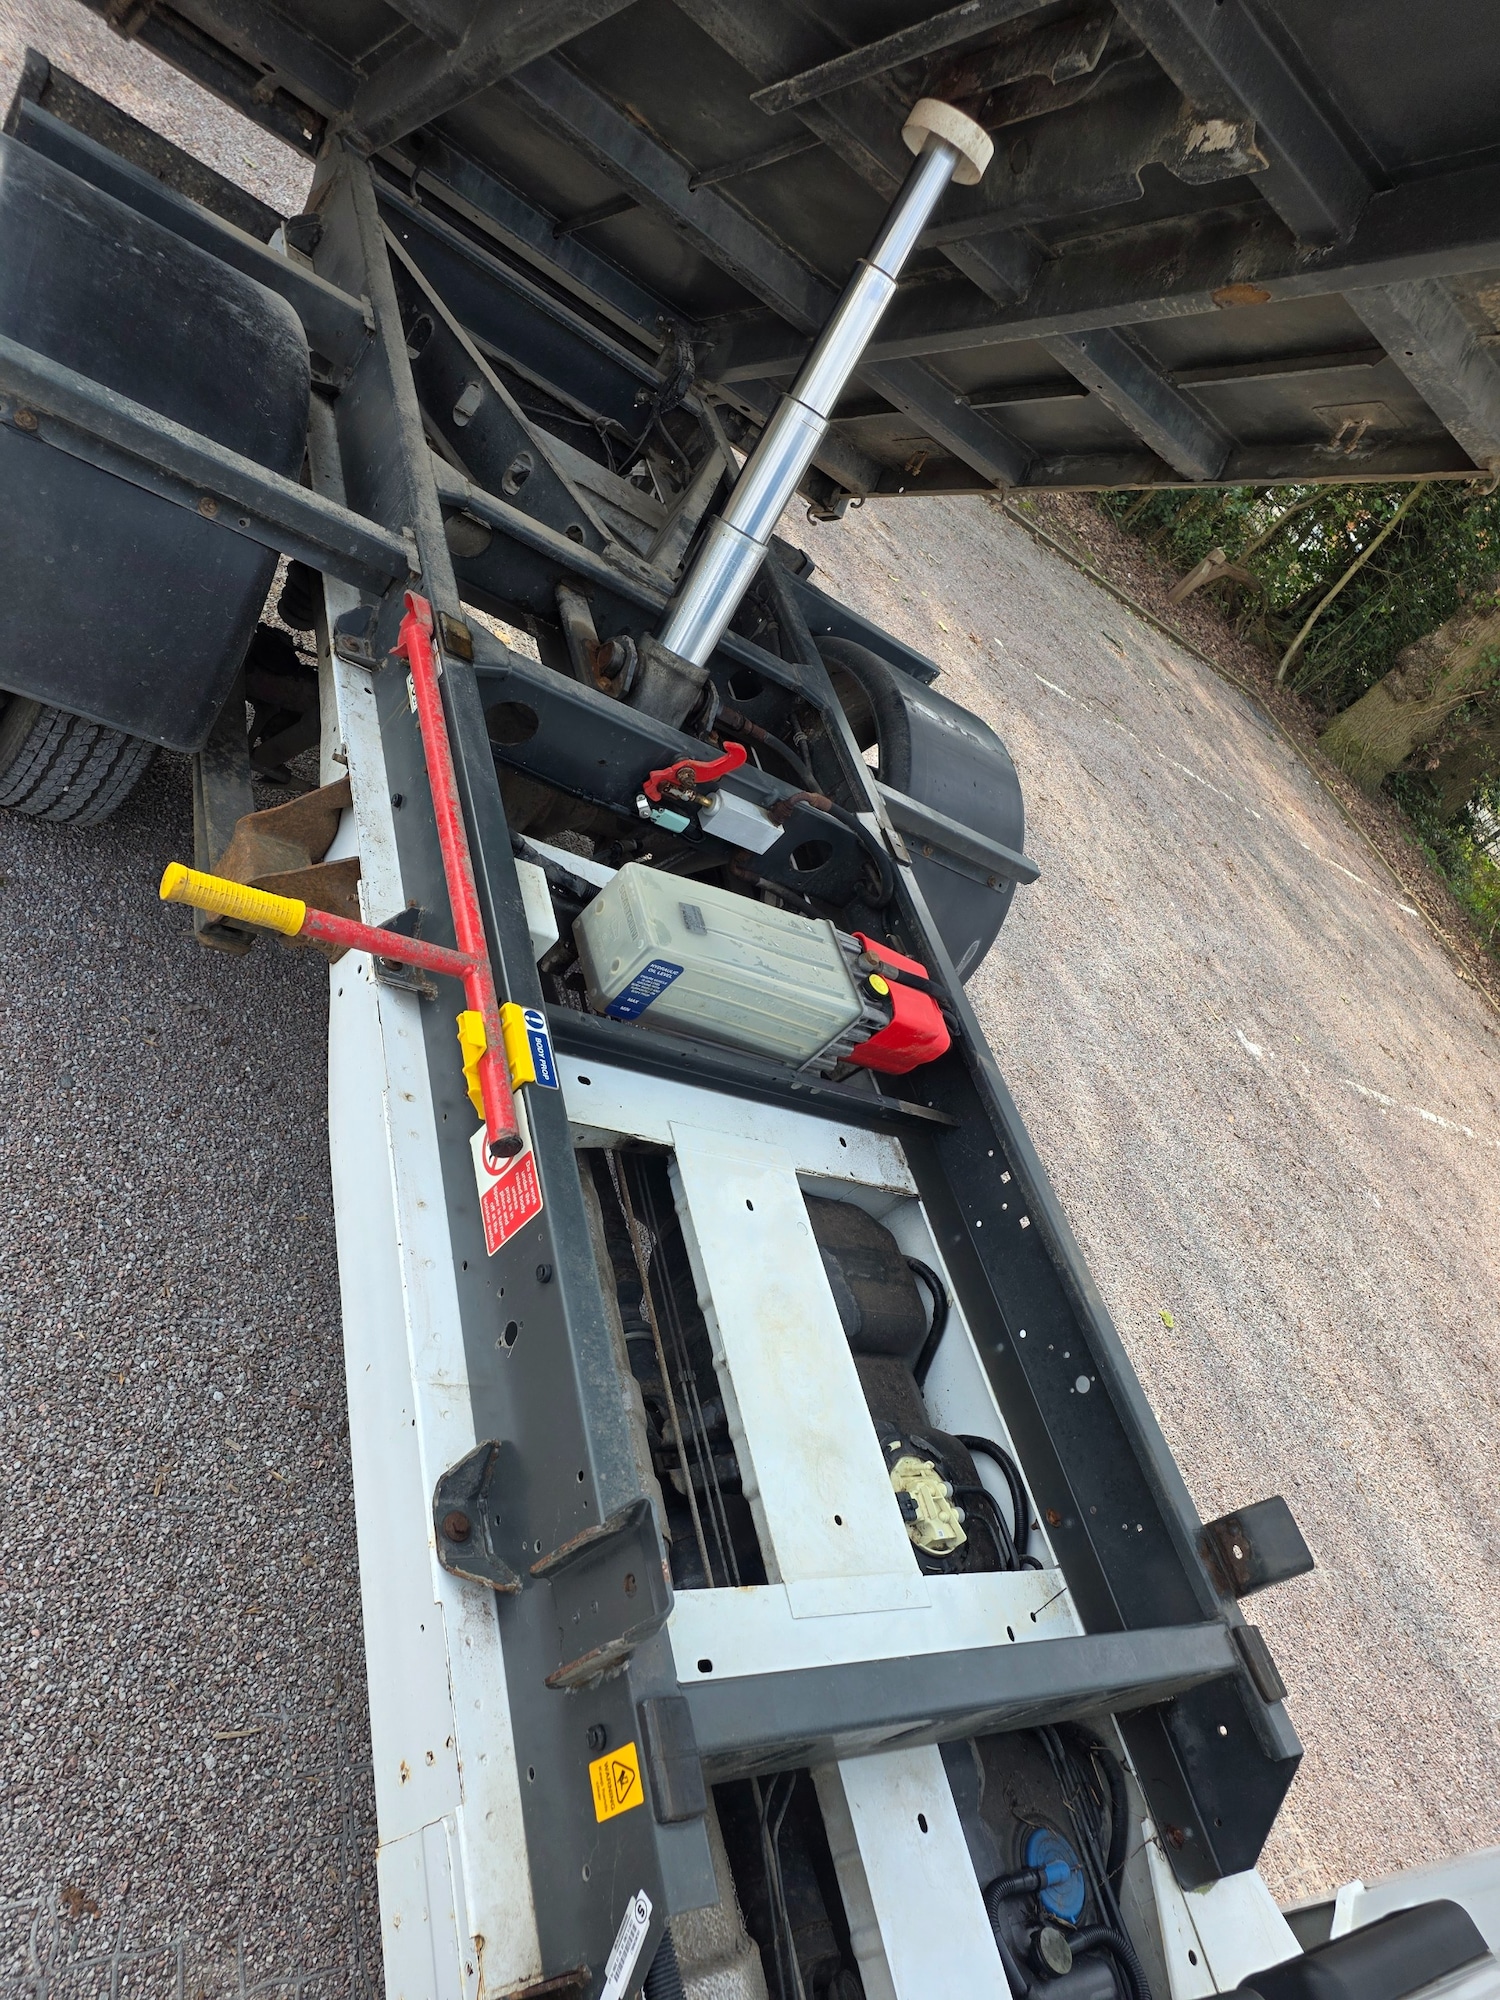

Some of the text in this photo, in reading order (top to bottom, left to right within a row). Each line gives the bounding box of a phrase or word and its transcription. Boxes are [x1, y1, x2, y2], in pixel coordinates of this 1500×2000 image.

[619, 884, 638, 941] SCATTOLINI
[650, 964, 679, 975] HYDRAULIC
[657, 971, 673, 979] LEVEL
[534, 1037, 550, 1081] BODY PROP
[526, 1160, 530, 1172] Do
[497, 1207, 501, 1215] is
[509, 1212, 515, 1220] in
[498, 1215, 506, 1240] turned
[604, 1761, 615, 1812] WARNING
